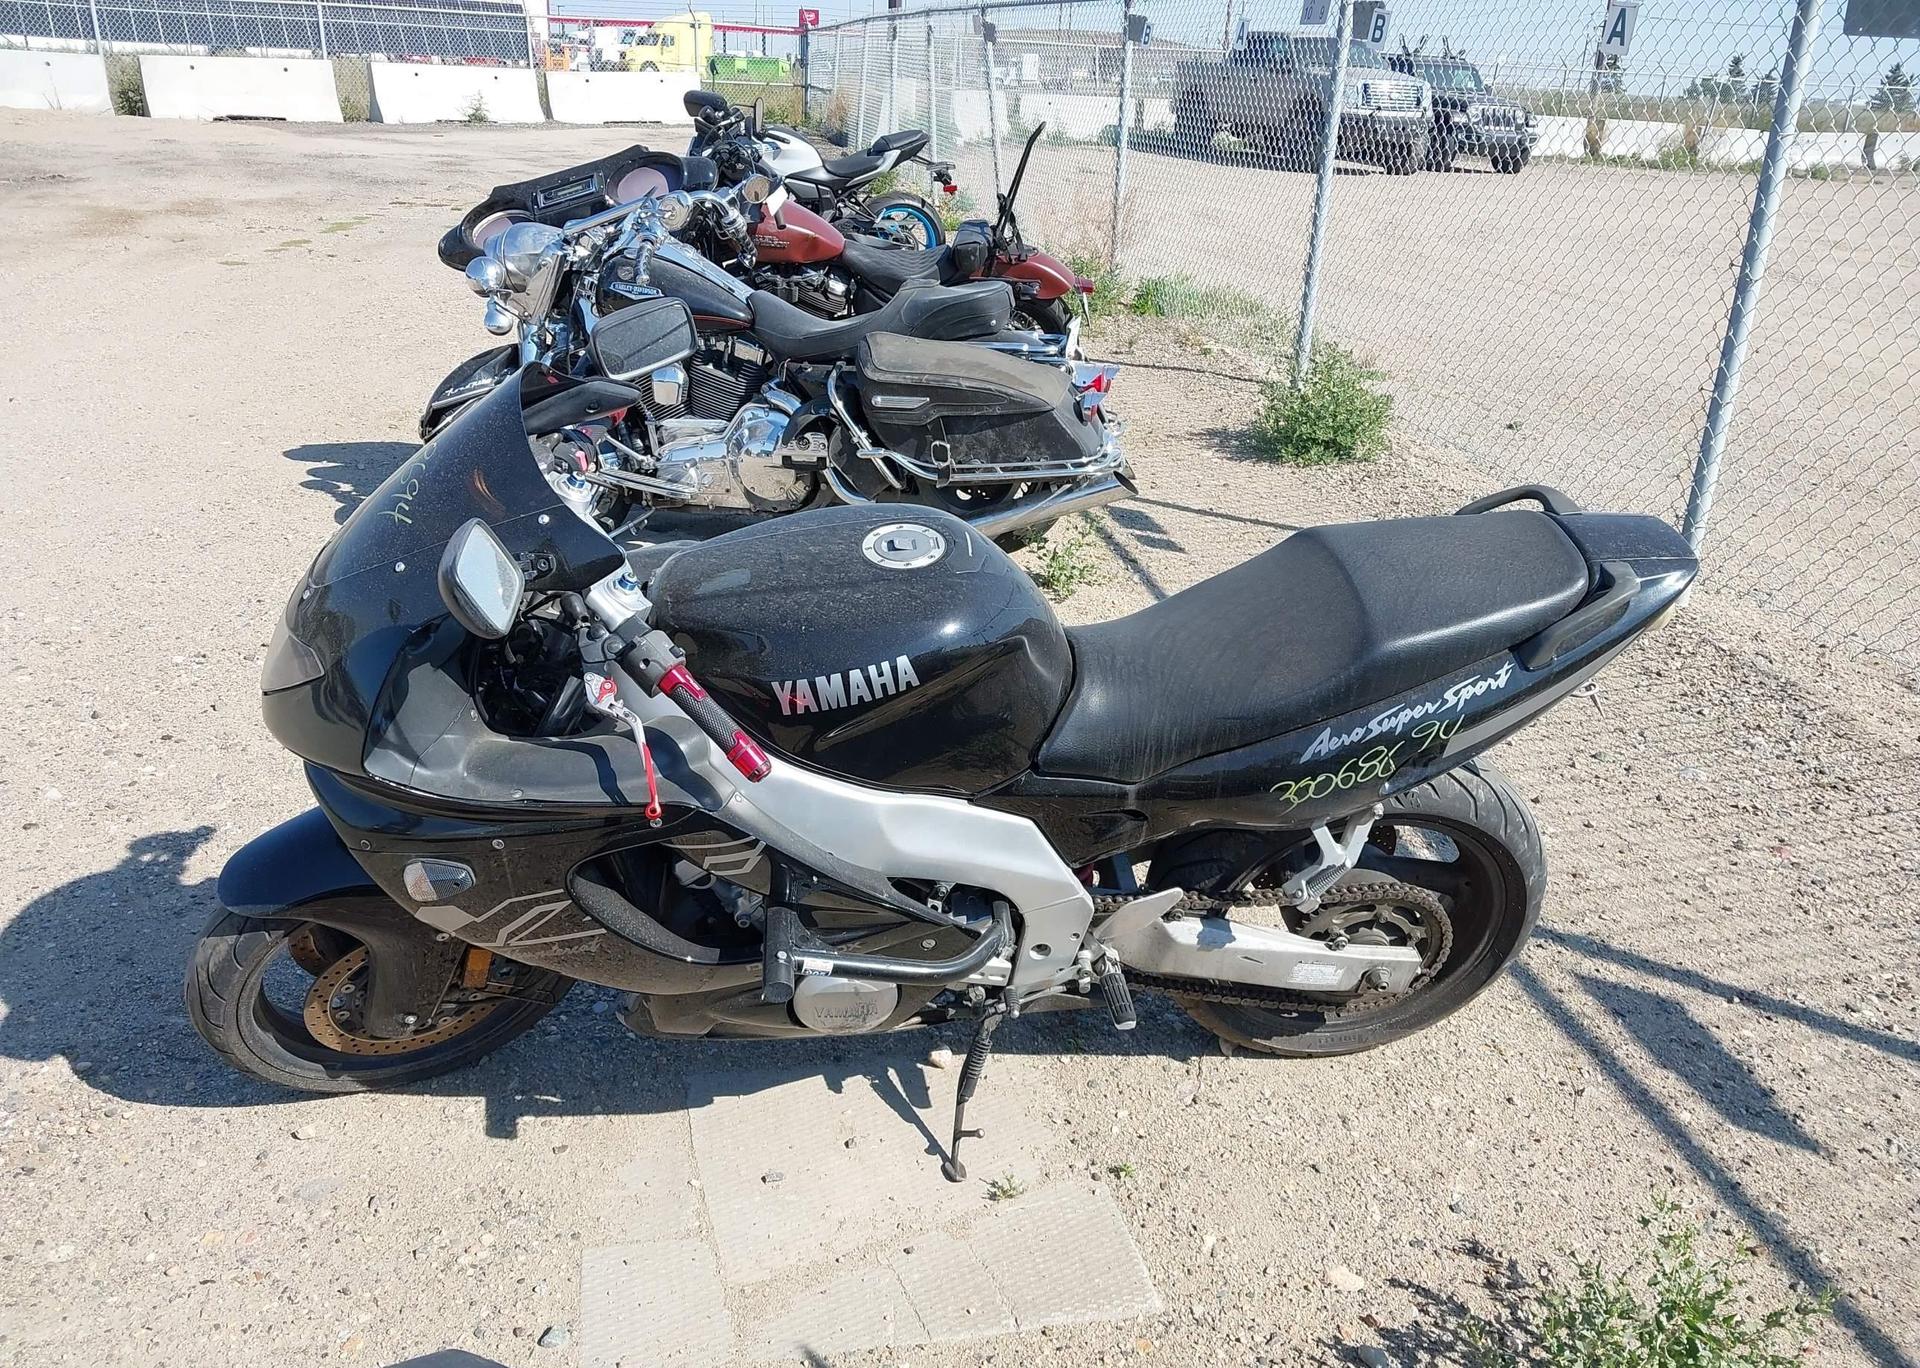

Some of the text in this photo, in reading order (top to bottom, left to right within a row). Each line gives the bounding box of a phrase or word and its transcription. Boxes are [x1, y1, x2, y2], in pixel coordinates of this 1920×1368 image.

[1142, 24, 1152, 45] B
[1236, 22, 1246, 46] A
[1371, 13, 1386, 43] B
[1606, 7, 1627, 46] A
[771, 654, 920, 716] YAMAHA
[1437, 661, 1515, 713] Sport
